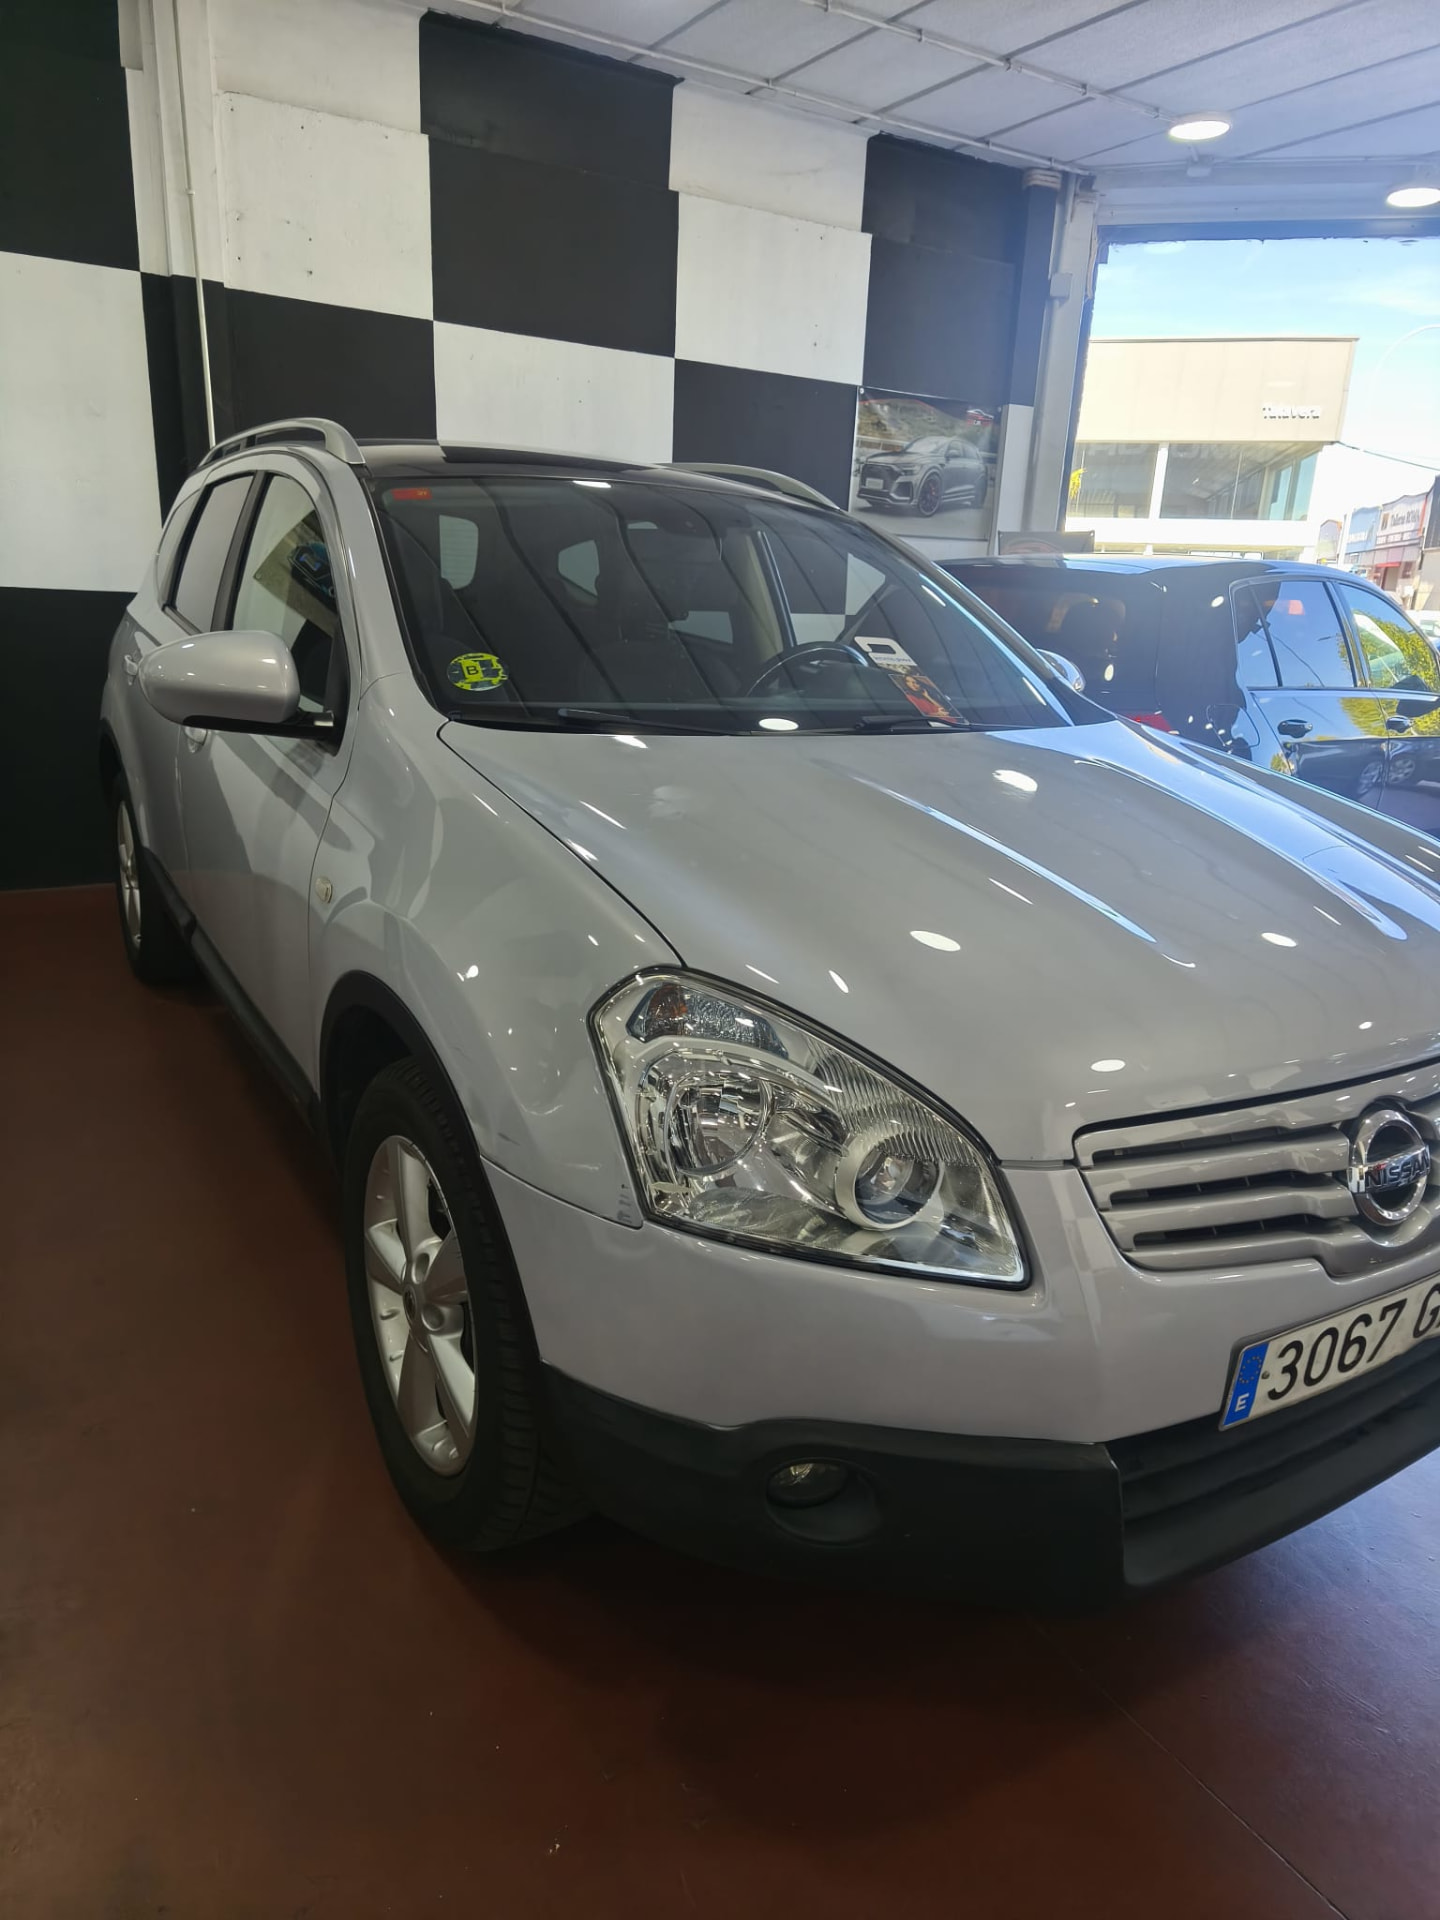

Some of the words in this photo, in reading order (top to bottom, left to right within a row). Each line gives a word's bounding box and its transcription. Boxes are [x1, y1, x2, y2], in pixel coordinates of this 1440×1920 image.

[466, 665, 479, 676] B
[1365, 1150, 1429, 1187] NISSAN
[1267, 1298, 1408, 1401] 3067
[1412, 1283, 1440, 1339] G
[1234, 1393, 1249, 1413] E
